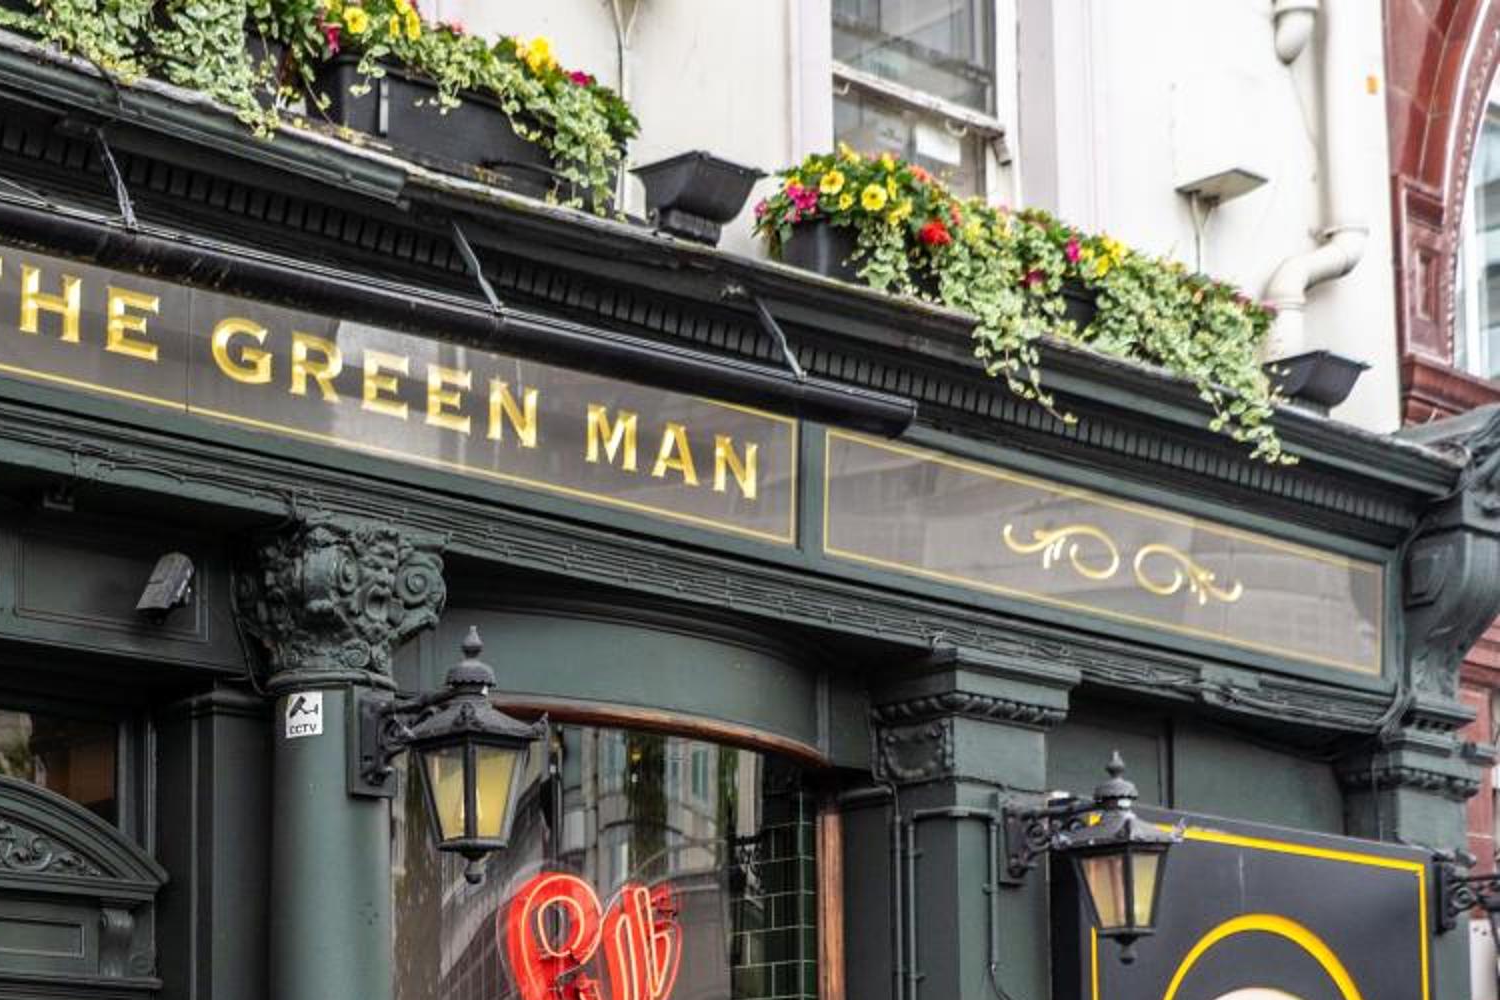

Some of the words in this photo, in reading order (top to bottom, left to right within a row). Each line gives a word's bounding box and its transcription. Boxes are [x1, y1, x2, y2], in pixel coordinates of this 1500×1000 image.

[211, 316, 540, 448] GREEN
[585, 402, 759, 500] MAN
[290, 723, 317, 735] CCTV
